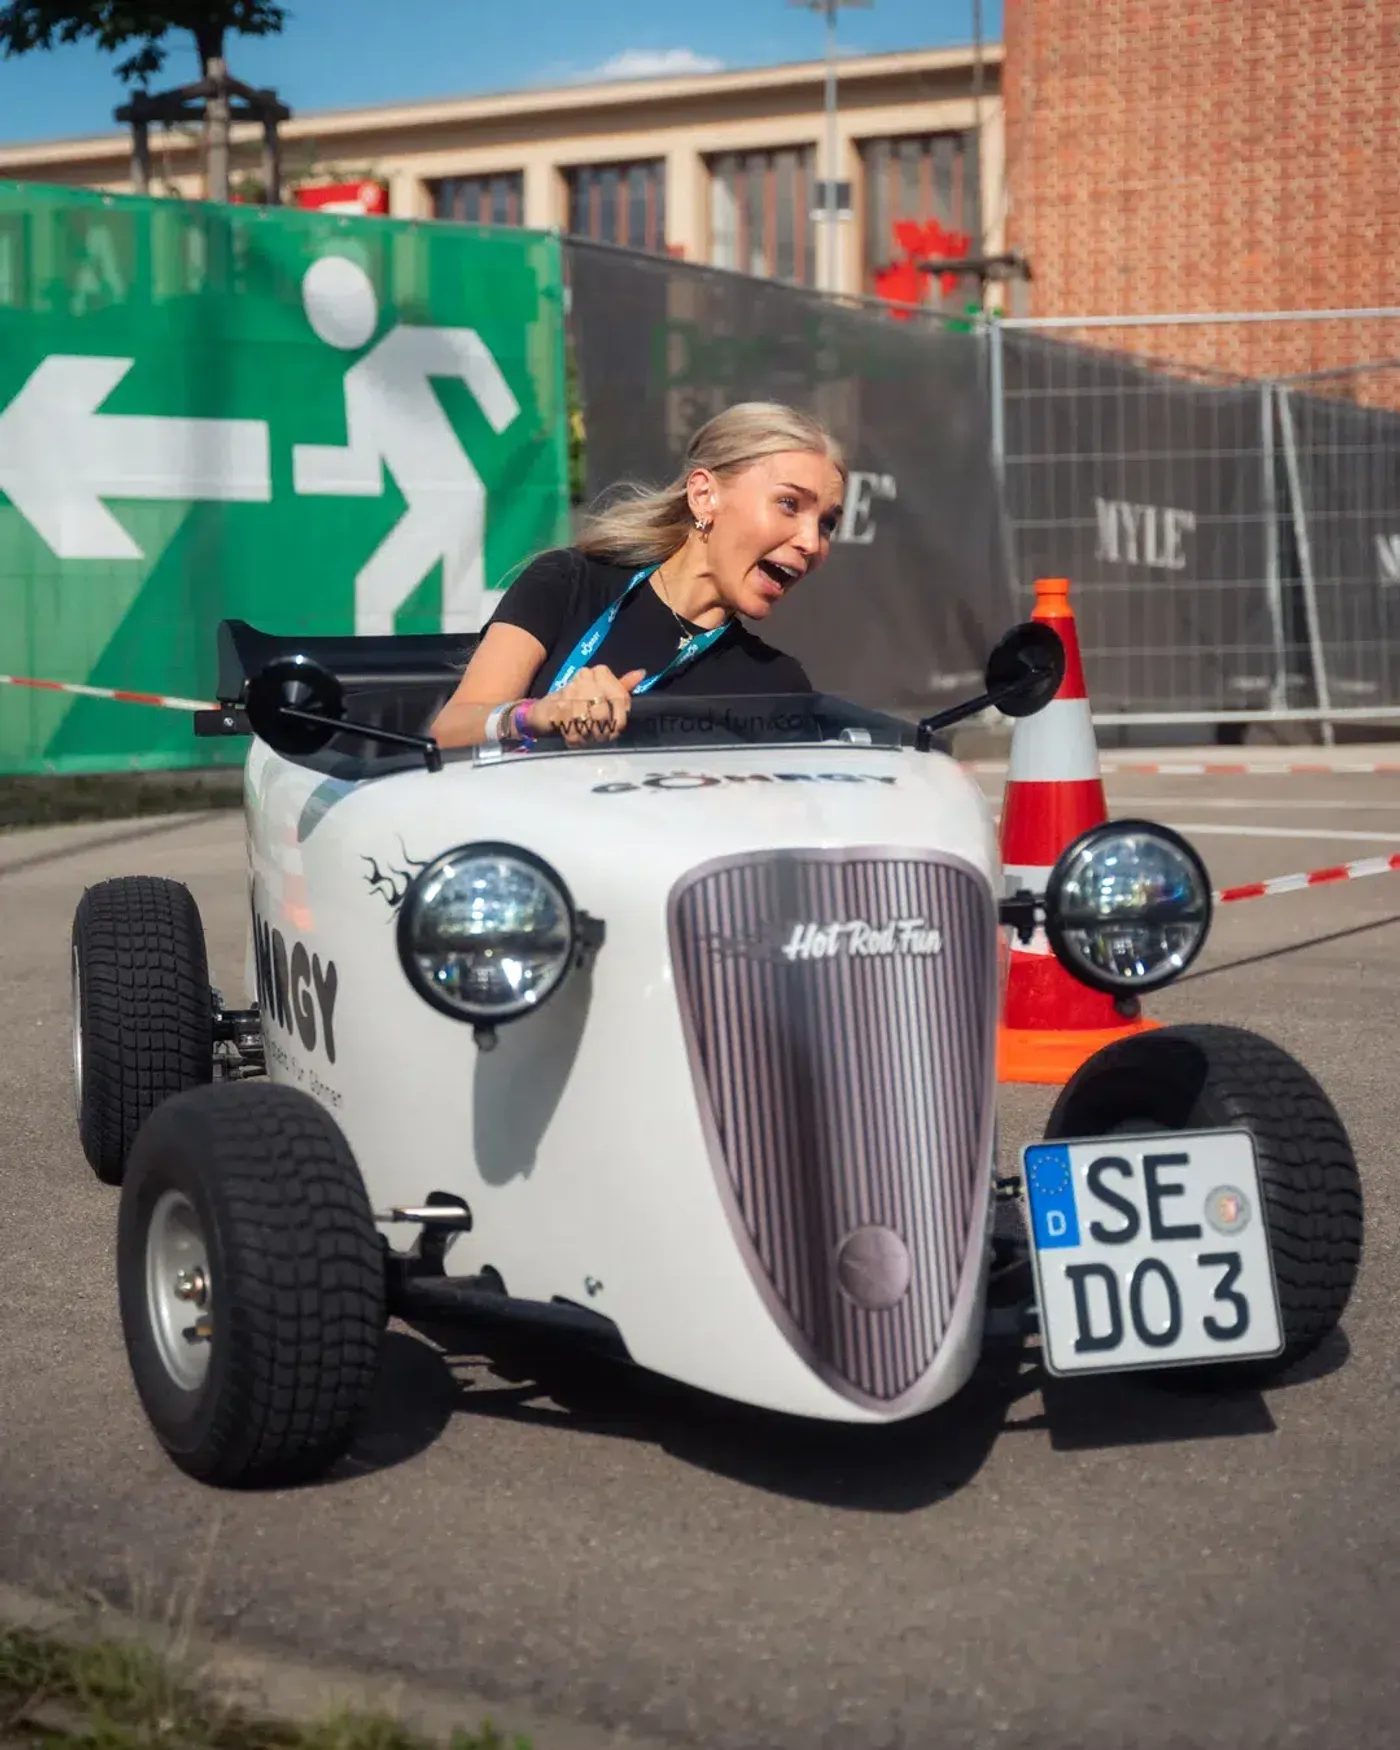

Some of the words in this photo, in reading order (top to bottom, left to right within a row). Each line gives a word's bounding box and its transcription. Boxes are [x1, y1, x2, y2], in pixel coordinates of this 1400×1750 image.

[781, 922, 843, 961] Hot
[844, 919, 898, 956] Rod
[898, 918, 943, 955] Fun
[1047, 1210, 1066, 1236] D
[1086, 1153, 1203, 1245] SE
[1197, 1252, 1249, 1341] 3
